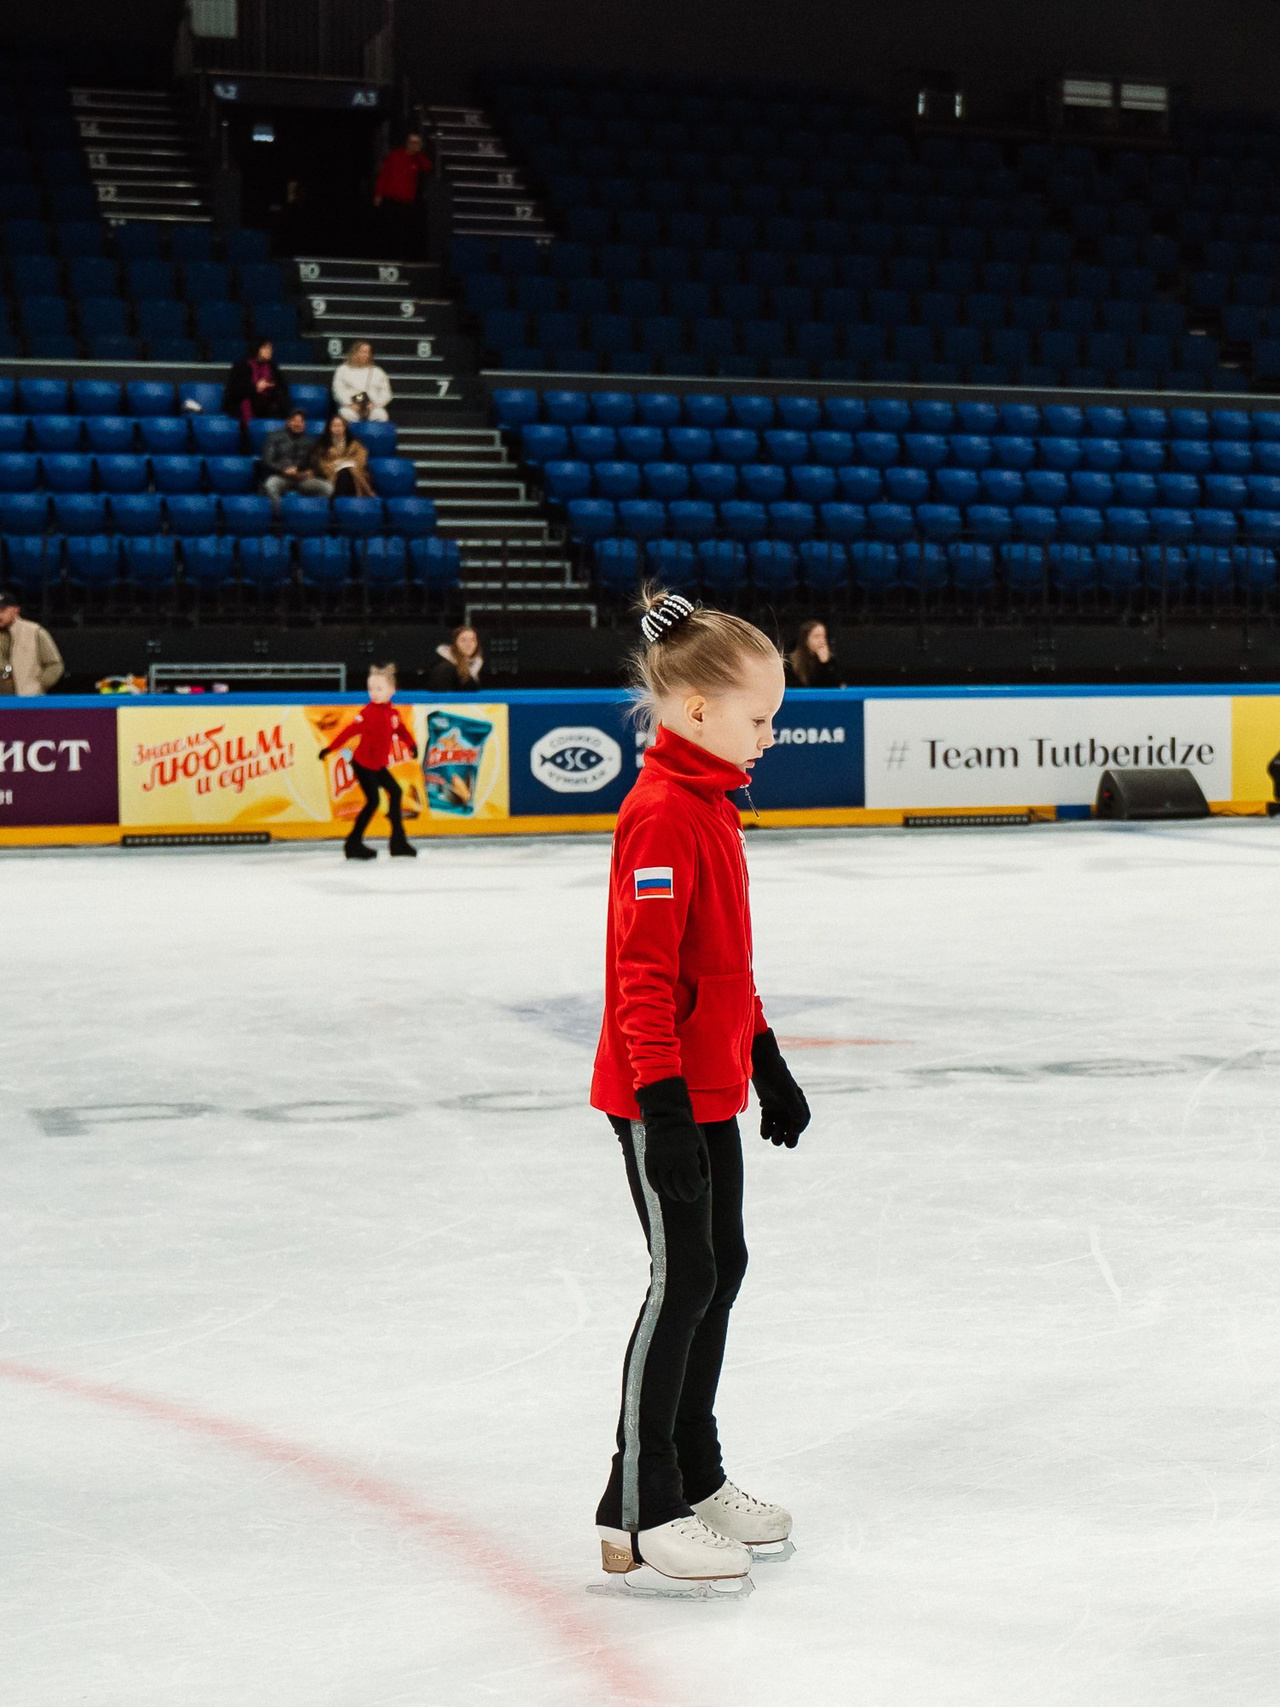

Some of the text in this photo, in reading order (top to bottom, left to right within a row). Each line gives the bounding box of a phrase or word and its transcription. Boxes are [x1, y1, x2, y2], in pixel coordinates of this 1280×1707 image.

[299, 263, 321, 280] 10
[378, 266, 400, 283] 10
[311, 299, 327, 316] 9
[400, 301, 416, 318] 9
[327, 338, 343, 356] 8
[417, 340, 432, 358] 8
[436, 380, 450, 397] 7
[142, 724, 284, 792] любим
[922, 738, 1019, 769] Team
[1028, 735, 1216, 768] Tutberidze
[218, 742, 295, 794] едим!
[196, 776, 212, 795] и
